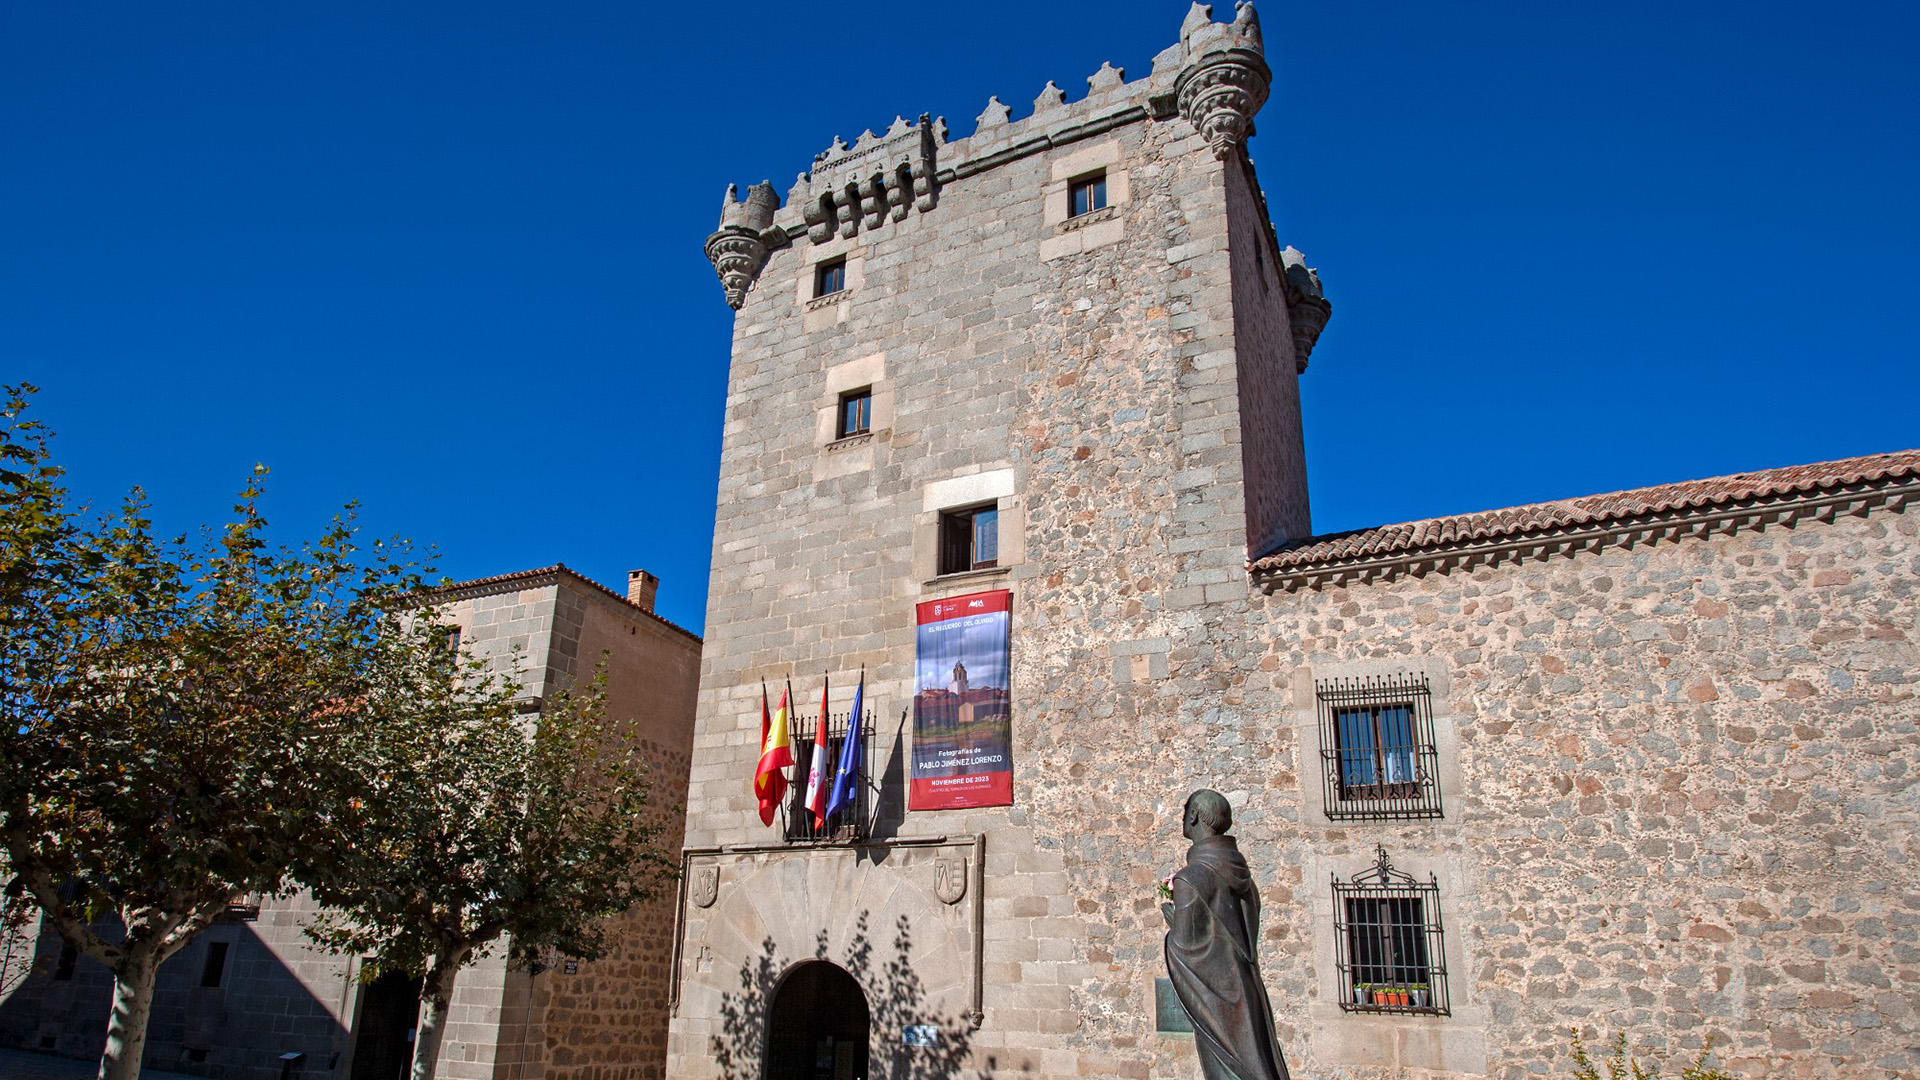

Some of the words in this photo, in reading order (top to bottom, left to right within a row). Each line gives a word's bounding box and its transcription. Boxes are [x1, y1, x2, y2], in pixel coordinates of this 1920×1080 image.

[938, 747, 973, 757] Fotografías
[919, 760, 940, 769] PABLO
[941, 756, 970, 768] JIMÉNEZ
[970, 755, 1002, 765] LORENZO
[931, 777, 964, 786] NOVIEMBRE
